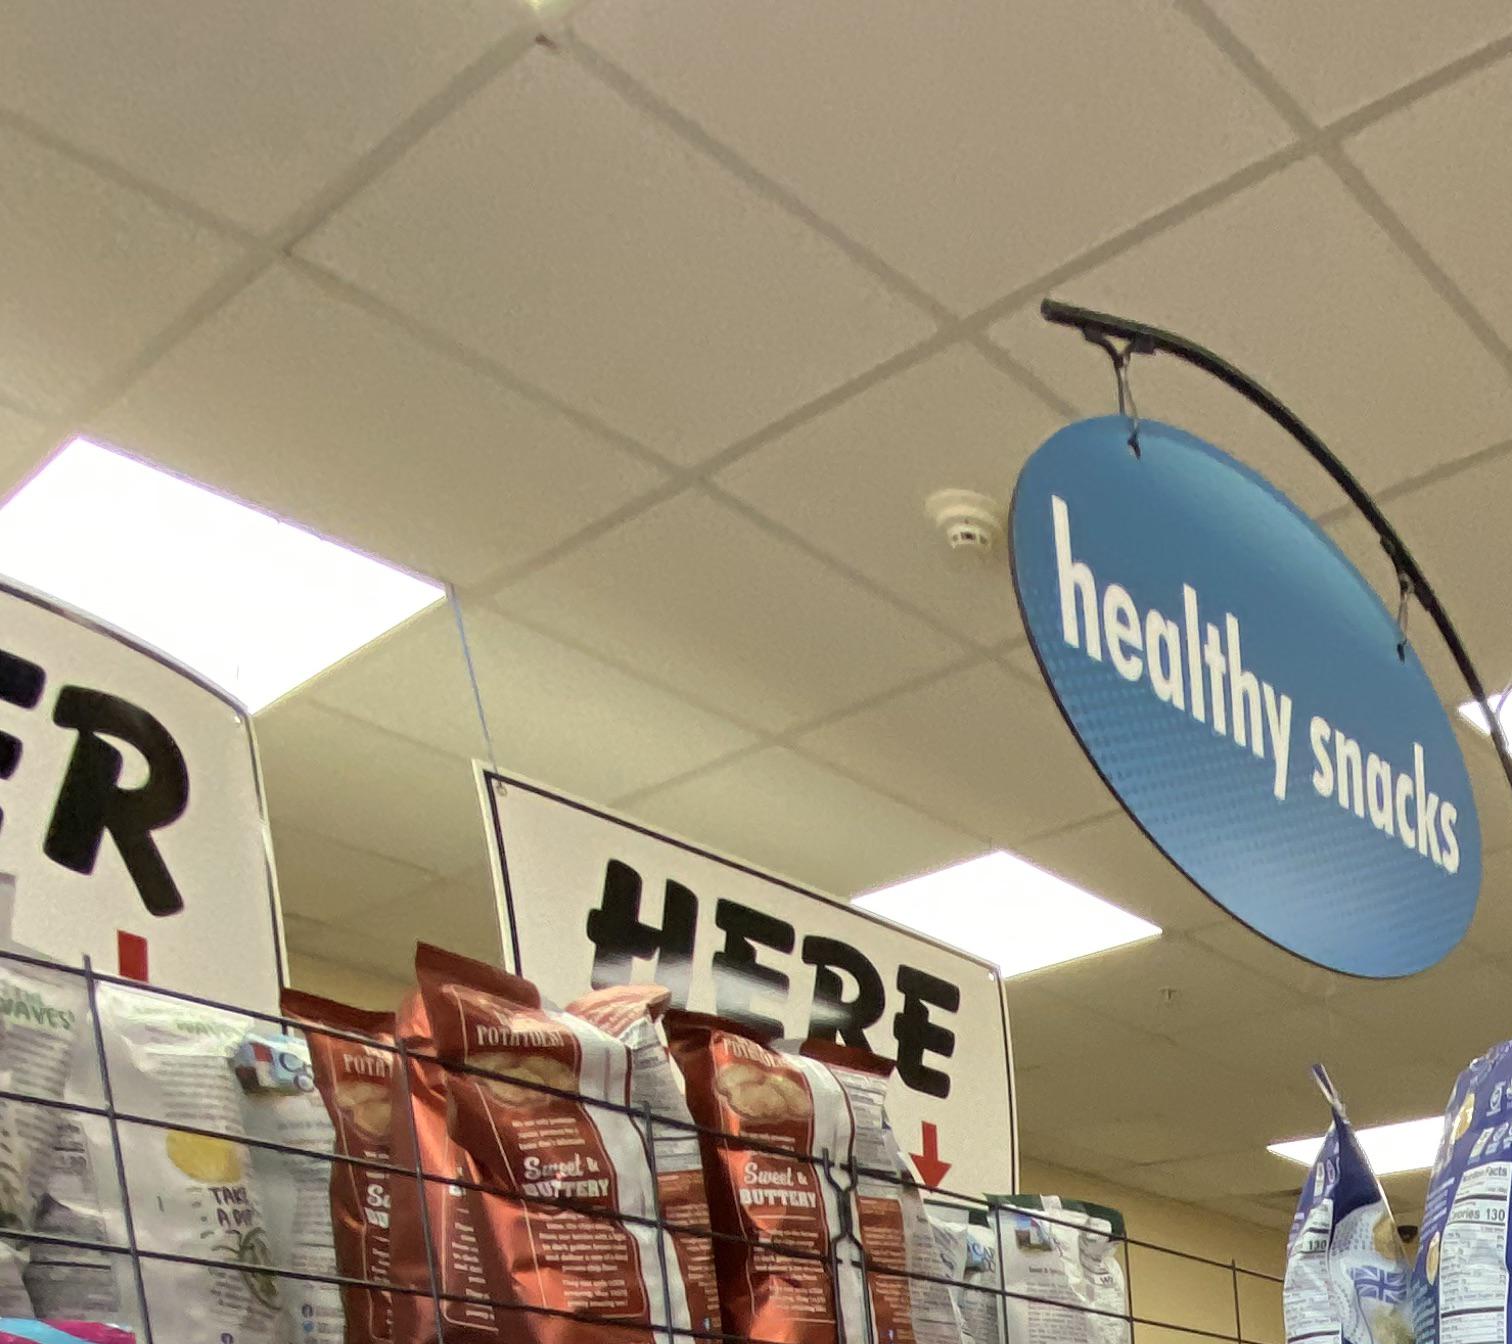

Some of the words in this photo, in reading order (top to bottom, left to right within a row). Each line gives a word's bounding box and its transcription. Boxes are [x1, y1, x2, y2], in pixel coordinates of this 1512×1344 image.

[1052, 495, 1293, 801] healthy
[1310, 715, 1462, 873] snacks
[739, 1187, 816, 1210] BUTTERY
[1484, 1207, 1506, 1222] 130
[1308, 1240, 1328, 1252] 130
